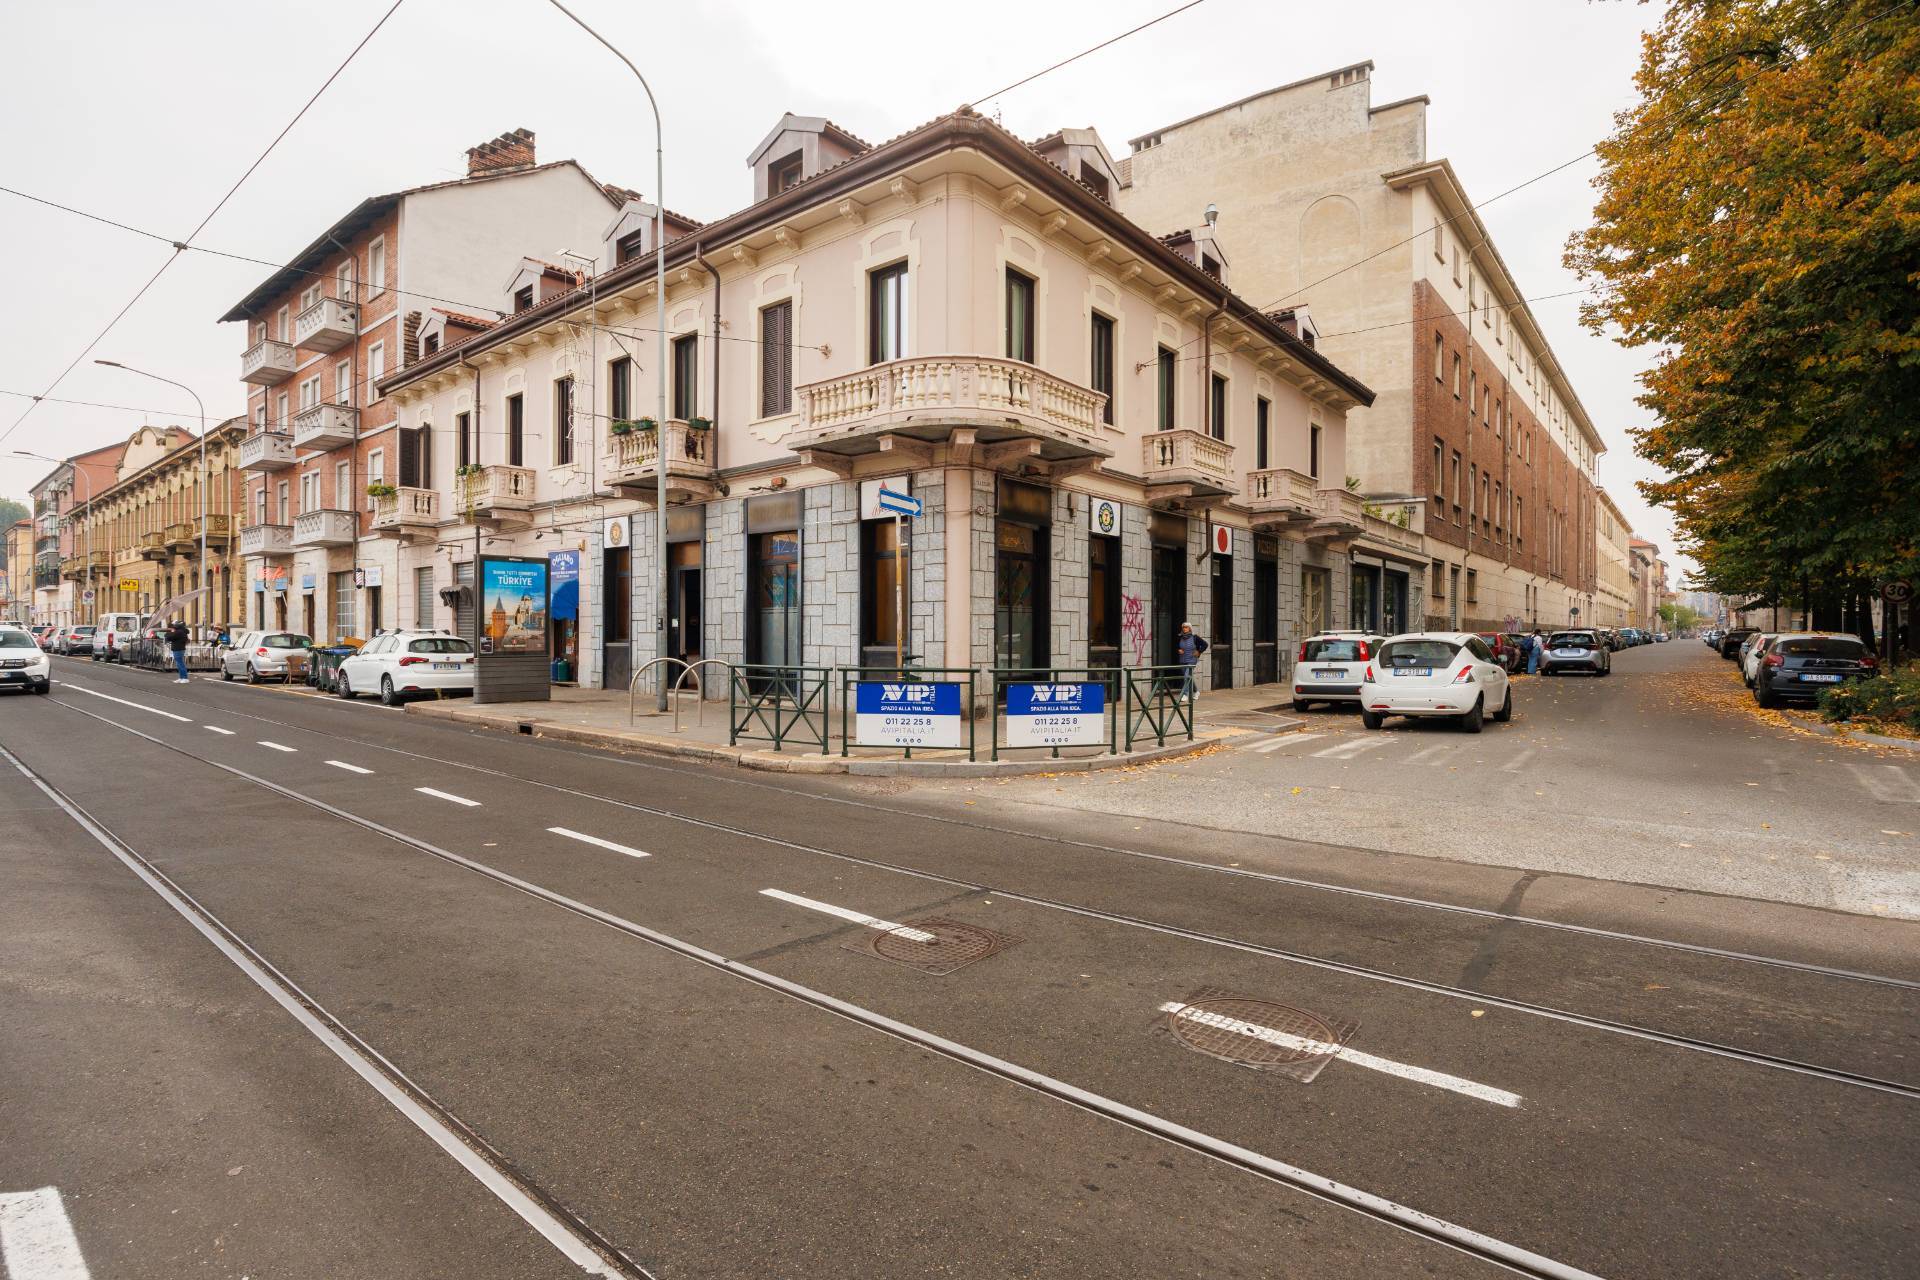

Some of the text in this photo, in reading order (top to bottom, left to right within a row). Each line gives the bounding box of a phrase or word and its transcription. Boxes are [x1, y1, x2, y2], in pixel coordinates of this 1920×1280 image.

[498, 574, 533, 586] TÜRKİYE
[881, 684, 930, 701] AVIP
[1030, 685, 1077, 701] AVIP
[885, 717, 898, 725] 011
[913, 718, 924, 726] 25
[925, 718, 932, 726] 8
[1034, 717, 1078, 726] 011 22 25 8
[880, 726, 936, 735] AVIPITALIA.IT
